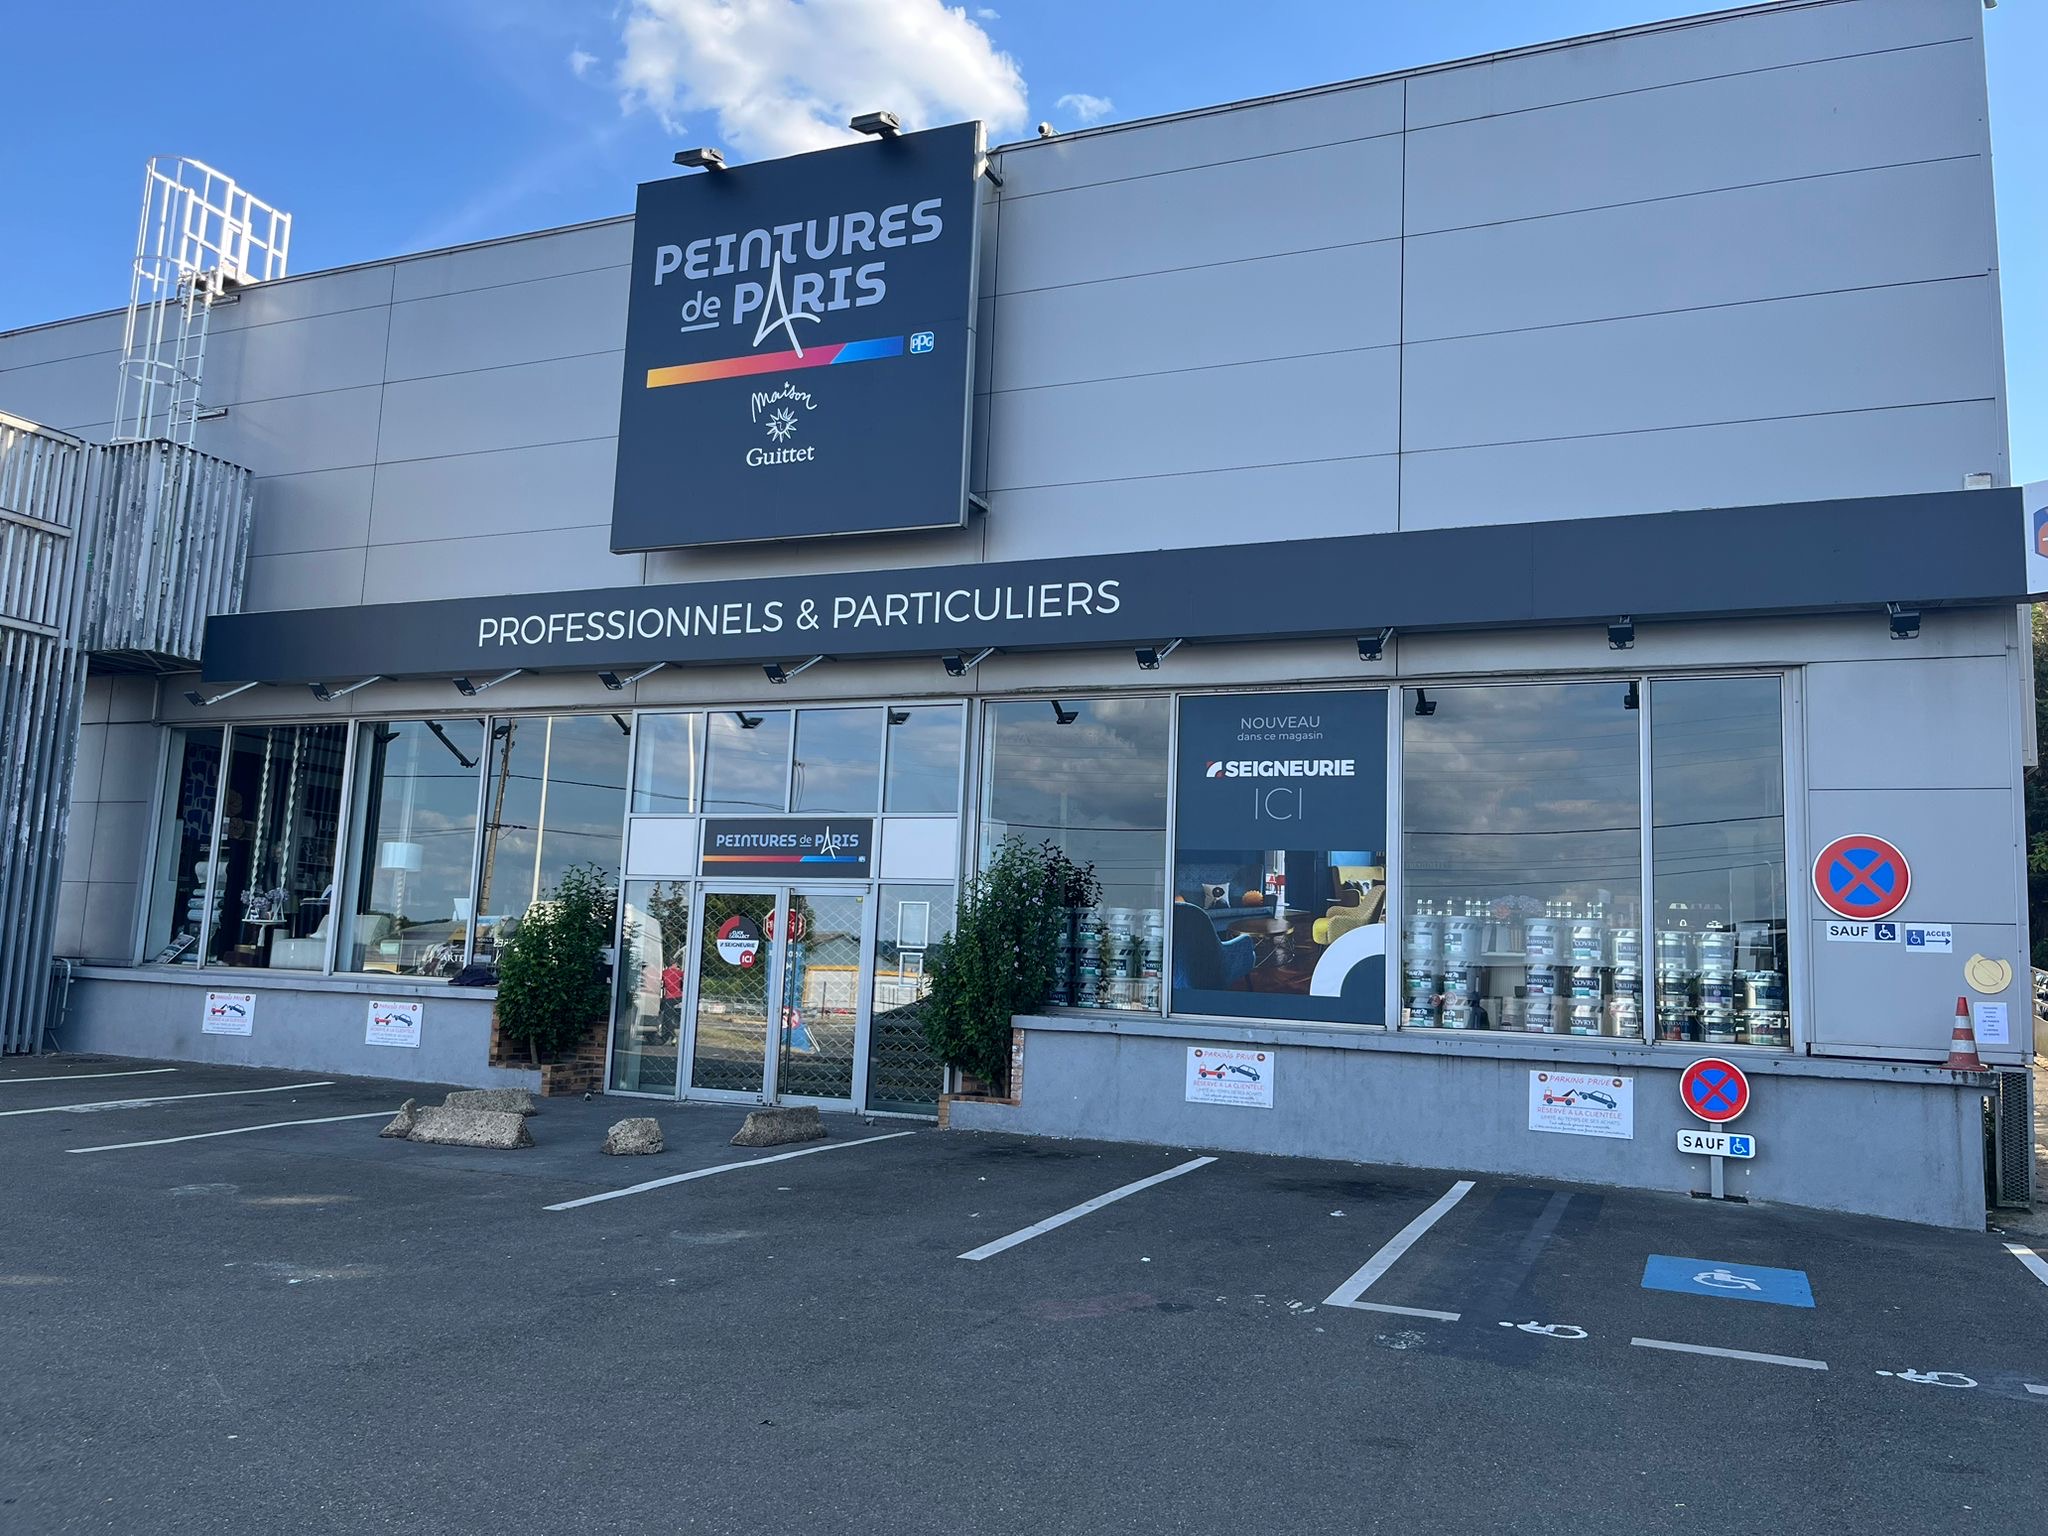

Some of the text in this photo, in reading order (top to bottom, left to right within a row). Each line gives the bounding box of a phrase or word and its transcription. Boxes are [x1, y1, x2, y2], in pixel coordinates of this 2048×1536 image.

[654, 198, 943, 286] PEINTURES
[681, 251, 887, 358] de PARIS
[911, 333, 933, 352] PPG
[746, 446, 815, 467] Guittet
[478, 579, 1121, 648] PROFESSIONNELS & PARTICULIERS
[1240, 716, 1321, 730] NOUVEAU
[1237, 731, 1324, 743] dans ce magasin
[1225, 759, 1355, 777] SEIGNEURIE
[1255, 787, 1302, 820] ICI
[716, 834, 797, 847] PEINTURES
[800, 834, 812, 847] de
[815, 826, 859, 859] PARIS
[1830, 925, 1869, 937] SAUF
[1925, 930, 1951, 938] ACCES
[742, 955, 752, 963] ICI
[1549, 1075, 1584, 1084] PARKING
[1683, 1135, 1725, 1150] SAUF
